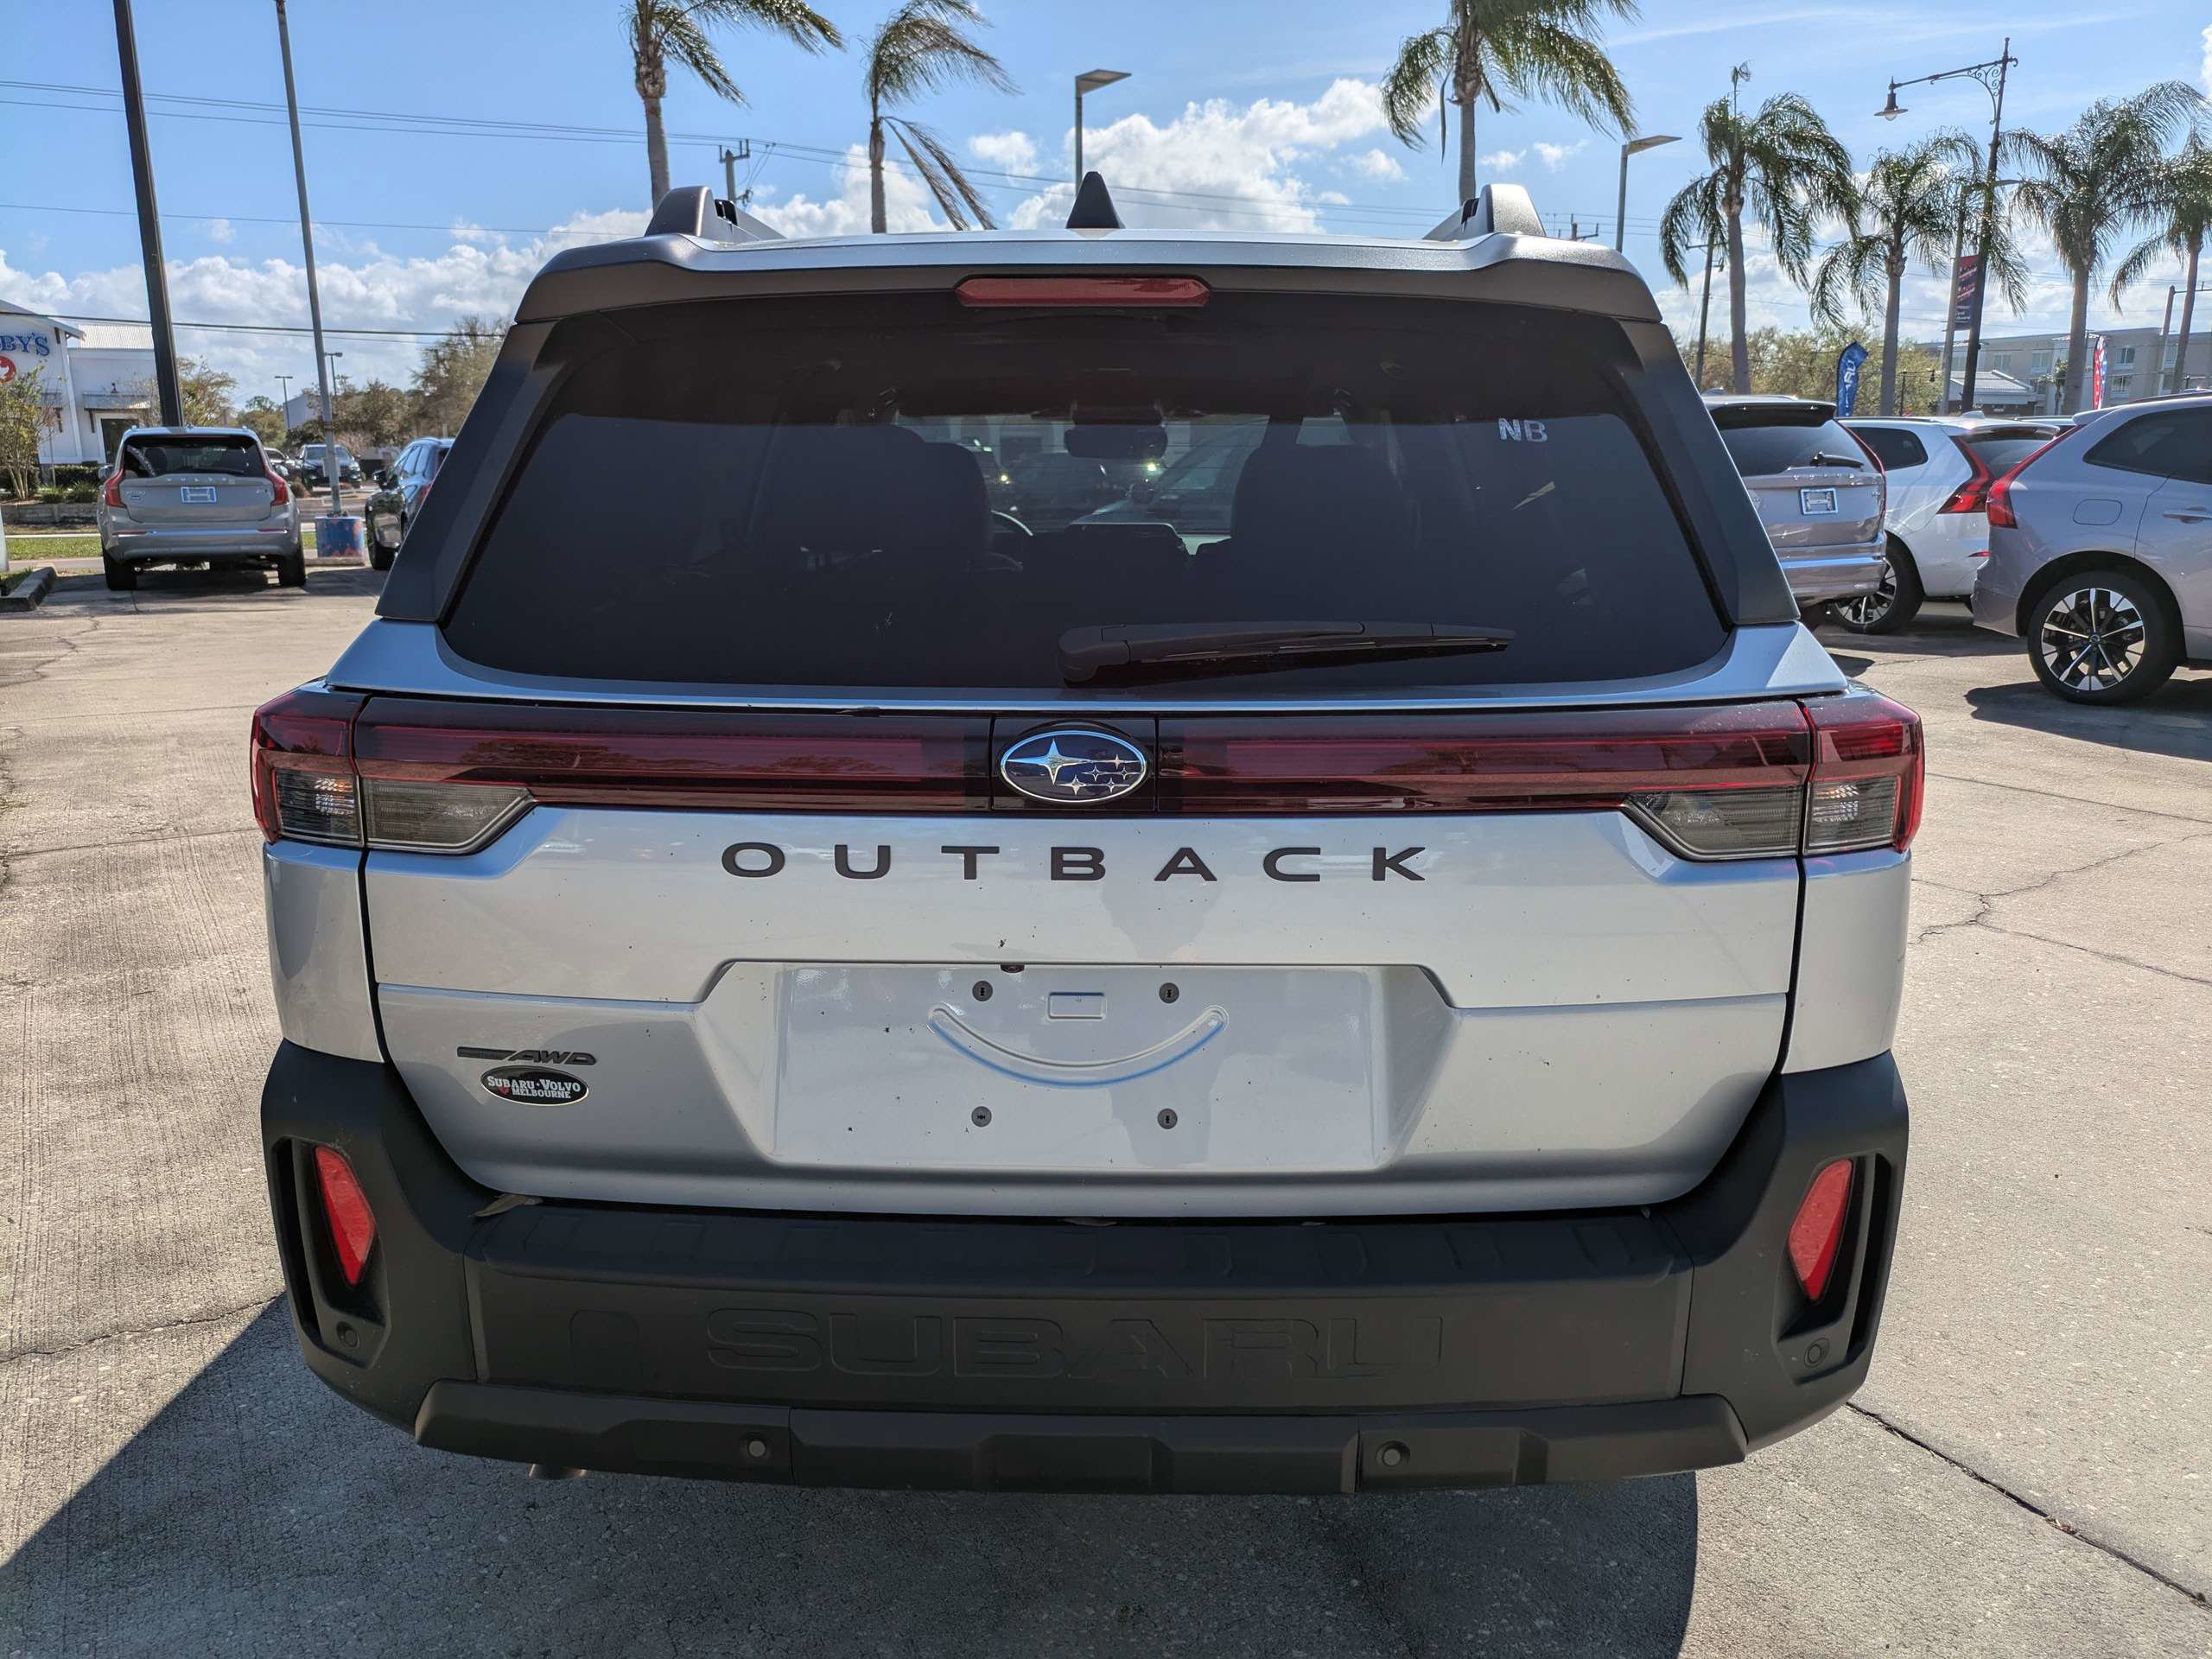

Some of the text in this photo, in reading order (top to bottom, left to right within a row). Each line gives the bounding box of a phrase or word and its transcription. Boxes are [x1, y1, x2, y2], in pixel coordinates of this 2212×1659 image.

[0, 333, 50, 357] BY'S
[1498, 417, 1548, 442] NB
[721, 841, 1427, 882] OUTBACK
[508, 1049, 597, 1065] AWD
[512, 1087, 572, 1099] MELBOURNE
[705, 1306, 1445, 1379] SUBARU
